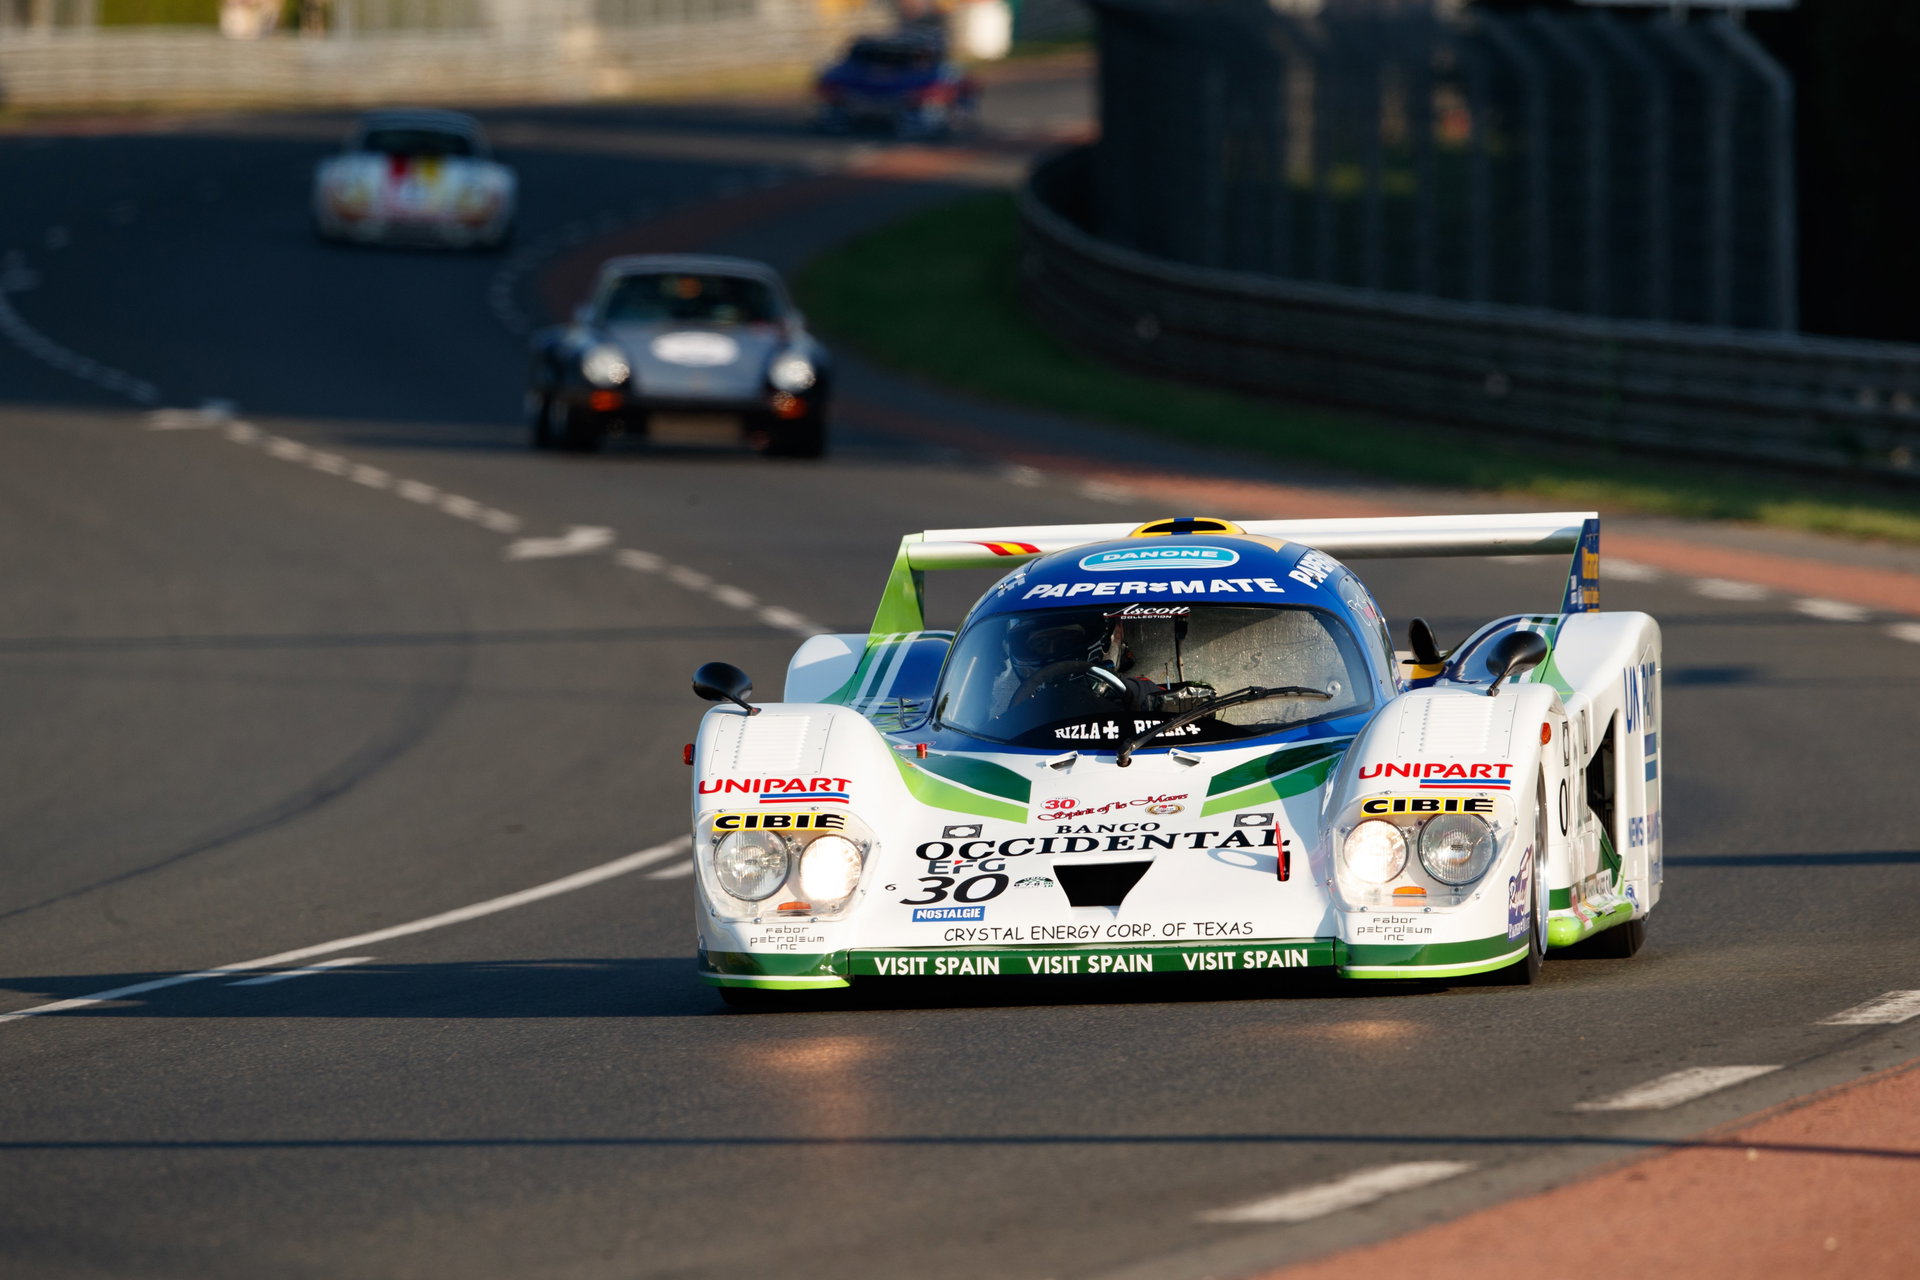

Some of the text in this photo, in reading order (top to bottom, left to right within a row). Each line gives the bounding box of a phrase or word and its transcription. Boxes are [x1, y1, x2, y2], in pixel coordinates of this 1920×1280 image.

[1103, 550, 1219, 561] DANONE
[1022, 581, 1148, 600] PAPER
[1172, 578, 1286, 595] MATE
[1103, 603, 1191, 617] Ascott
[1358, 762, 1514, 780] UNIPART
[698, 777, 852, 795] UNIPART
[1044, 799, 1076, 809] 30
[1097, 802, 1115, 814] of
[1055, 822, 1161, 835] BANCO
[915, 828, 1292, 861] OCCIDENTAL
[927, 858, 1006, 875] EFG
[884, 883, 897, 891] 6
[899, 873, 1010, 905] 30
[916, 908, 981, 920] NOSTALGIE
[944, 921, 1254, 942] CRYSTAL ENERGY CORP. OF TEXAS
[874, 956, 1000, 976] VISIT SPAIN
[1027, 954, 1154, 974] VISIT SPAIN
[1182, 949, 1309, 971] VISIT SPAIN
